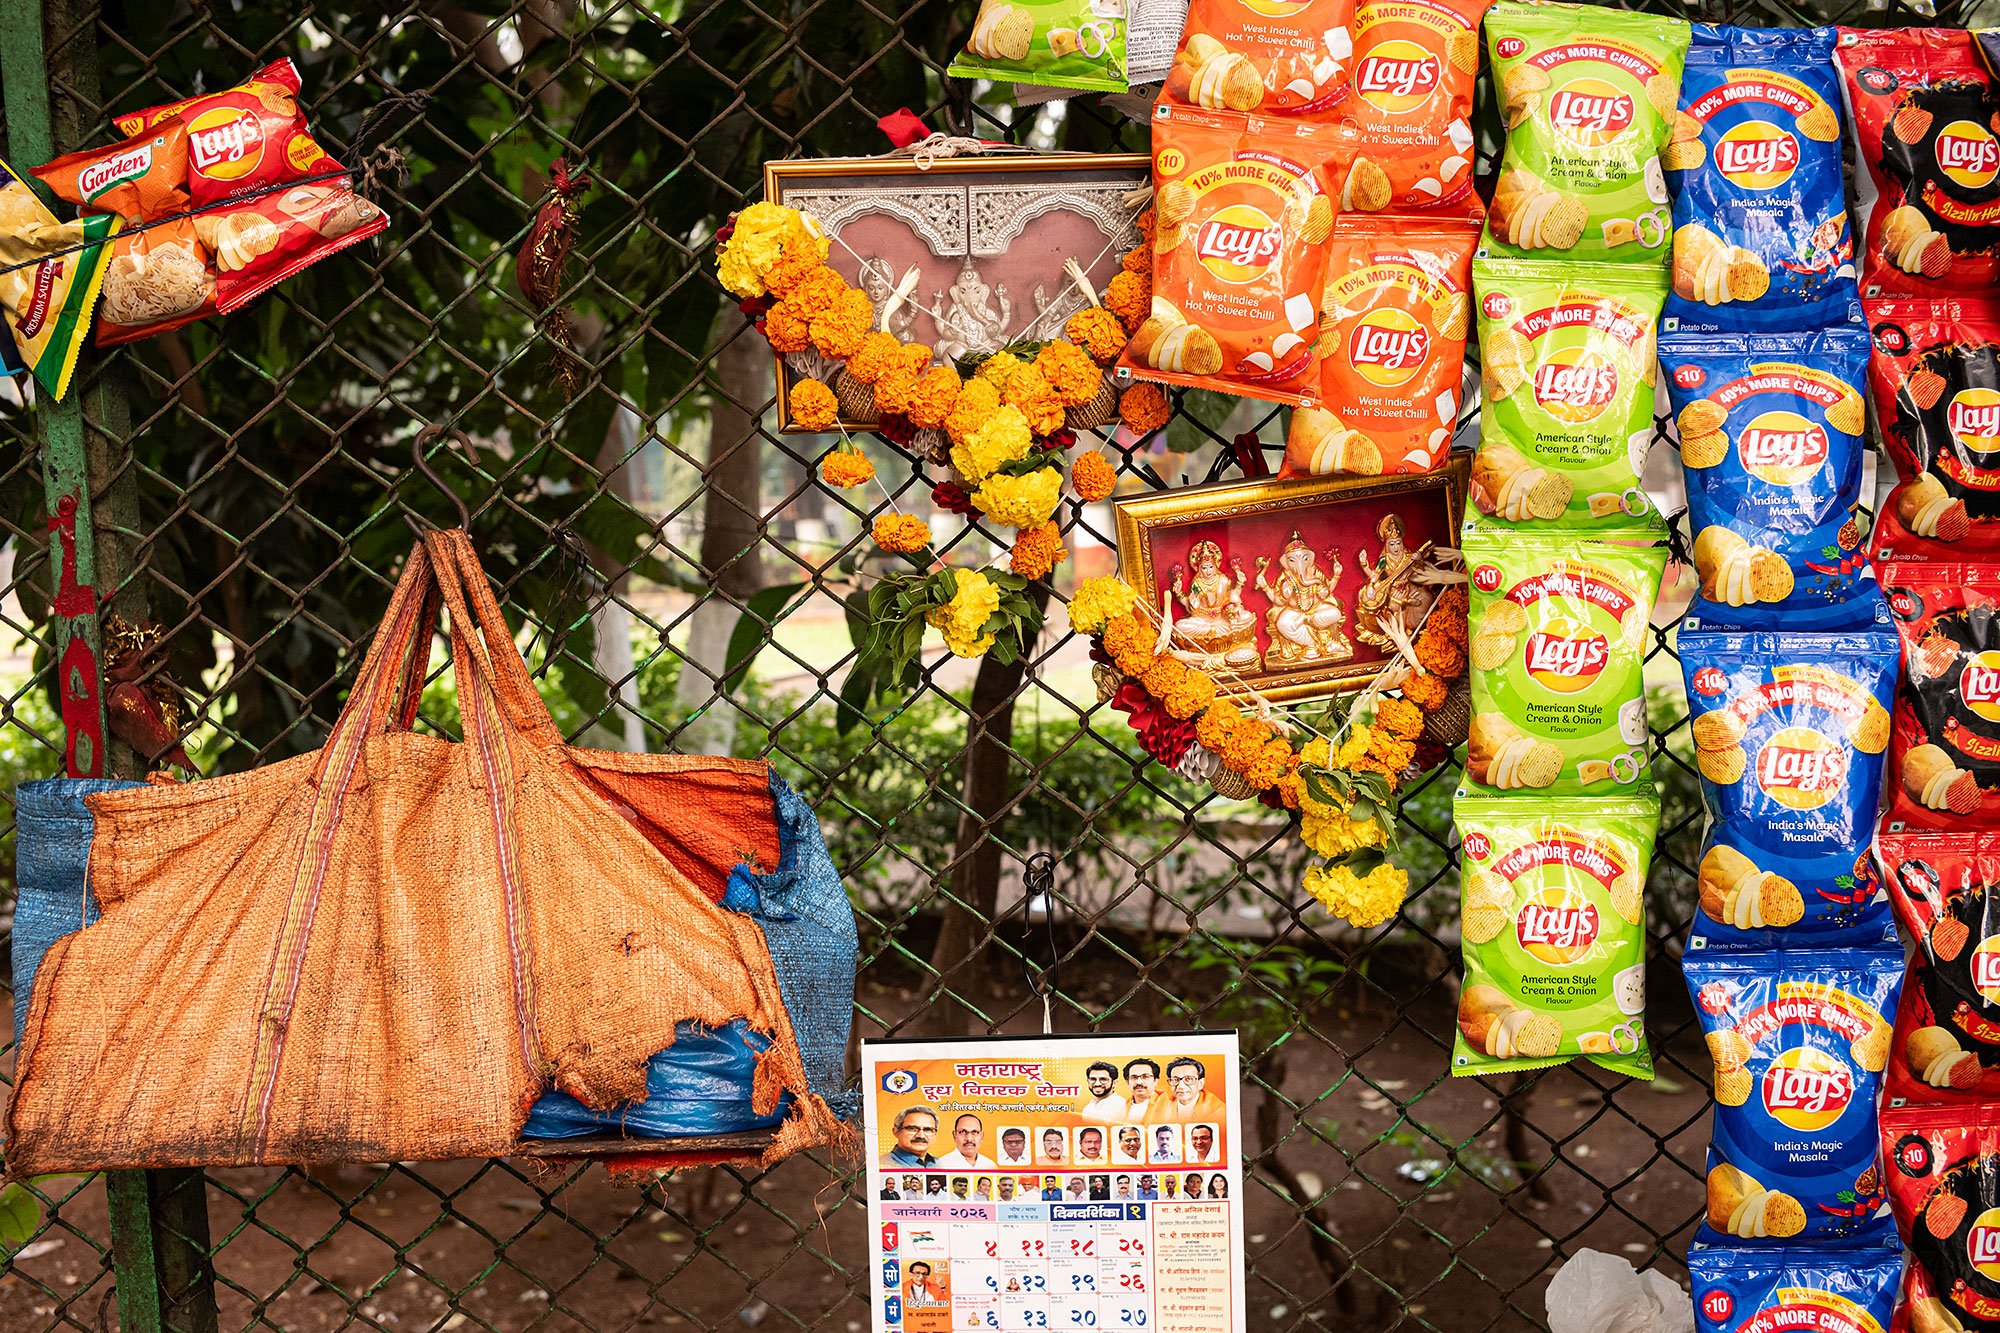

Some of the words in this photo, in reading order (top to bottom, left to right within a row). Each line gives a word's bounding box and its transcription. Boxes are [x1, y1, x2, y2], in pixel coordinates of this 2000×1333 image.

[1377, 7, 1416, 19] MORE
[1243, 24, 1267, 34] West
[1226, 33, 1242, 41] Hot
[1257, 35, 1288, 46] Sweet
[1289, 37, 1316, 50] Chilli
[1878, 37, 1895, 46] Chips
[1536, 50, 1567, 67] 10%
[1567, 46, 1607, 59] MORE
[1360, 57, 1435, 97] Lay's
[1777, 77, 1800, 90] PERFECT
[1694, 95, 1723, 119] 40%
[1722, 85, 1764, 102] MORE
[1172, 113, 1191, 122] Potato
[1192, 115, 1209, 124] Chips
[1554, 91, 1630, 132] Lay's
[1366, 123, 1392, 134] West
[190, 115, 262, 169] Lay's
[1382, 134, 1413, 146] Sweet
[1414, 134, 1440, 146] Chilli
[1722, 136, 1796, 175] Lay's
[1942, 136, 1998, 173] Lay's
[81, 154, 147, 193] Garden
[1281, 161, 1305, 175] PERFECT
[1551, 167, 1584, 178] Cream
[1586, 168, 1595, 178] &
[1192, 170, 1222, 190] 10%
[1225, 165, 1265, 180] MORE
[1574, 180, 1602, 188] Flavour
[229, 179, 266, 198] Spanish
[1731, 198, 1765, 207] India's
[1766, 198, 1796, 209] Magic
[1746, 208, 1784, 218] Masala
[1200, 221, 1283, 267] Lay's
[1338, 276, 1365, 296] 10%
[1366, 270, 1404, 283] MORE
[24, 299, 46, 336] PREMIUM
[37, 266, 52, 300] SALTED
[1202, 290, 1227, 302] West
[1185, 300, 1202, 311] Hot
[1217, 304, 1248, 318] Sweet
[1249, 307, 1275, 321] Chilli
[1522, 315, 1550, 335] 10%
[1550, 308, 1592, 323] MORE
[1680, 324, 1700, 332] Potato
[1701, 323, 1719, 332] Chips
[1353, 325, 1422, 370] Lay's
[1719, 383, 1749, 404] 40%
[1749, 377, 1790, 391] MORE
[1358, 396, 1383, 407] West
[1342, 406, 1360, 416] Hot
[1374, 407, 1403, 418] Sweet
[1404, 408, 1428, 419] Chilli
[1535, 432, 1585, 444] American
[1586, 434, 1613, 446] Style
[1535, 444, 1570, 455] Cream
[1572, 445, 1580, 455] &
[1582, 445, 1612, 456] Onion
[1745, 427, 1824, 469] Lay's
[1559, 456, 1587, 464] Flavour
[1753, 495, 1788, 505] India's
[1515, 582, 1542, 603] 10%
[1541, 579, 1581, 593] MORE
[1723, 624, 1741, 632] Chips
[1530, 634, 1604, 677] Lay's
[1770, 685, 1813, 702] MORE
[1526, 702, 1576, 714] American
[1577, 703, 1603, 717] Style
[1526, 713, 1561, 724] Cream
[1562, 714, 1571, 724] &
[1572, 714, 1602, 725] Onion
[1550, 725, 1577, 734] Flavour
[1763, 747, 1842, 792] Lay's
[1768, 820, 1804, 830] India's
[1805, 820, 1840, 833] Magic
[1782, 832, 1825, 842] Masala
[1502, 853, 1532, 875] 10%
[1532, 846, 1571, 860] MORE
[1521, 973, 1570, 985] American
[1572, 974, 1597, 987] Style
[1521, 985, 1556, 996] Cream
[1557, 986, 1566, 996] &
[1567, 985, 1597, 996] Onion
[1546, 997, 1573, 1005] Flavour
[1774, 1003, 1817, 1020] MORE
[956, 1063, 1043, 1082] महाराष्ट्र
[922, 1084, 953, 1101] दूध
[961, 1082, 1029, 1097] वितरक
[1037, 1082, 1081, 1097] सेना
[1769, 1066, 1847, 1114] Lay's
[1773, 1141, 1809, 1151] India's
[1811, 1140, 1843, 1154] Magic
[1788, 1152, 1828, 1162] Masala
[891, 1206, 943, 1218] जानेवारी
[950, 1207, 988, 1220] २०२६
[1052, 1204, 1121, 1219] दिनदर्शिका
[1129, 1205, 1142, 1219] १
[885, 1232, 896, 1247] र
[1021, 1239, 1044, 1257] ११
[1070, 1239, 1094, 1256] १८
[1119, 1238, 1145, 1256] २५
[984, 1240, 997, 1257] ४
[884, 1264, 898, 1283] सो
[985, 1275, 998, 1293] ५
[1023, 1275, 1047, 1293] १२
[1071, 1274, 1096, 1292] १९
[1120, 1274, 1145, 1293] २६
[888, 1302, 898, 1318] मं
[1071, 1309, 1096, 1327] २०
[1120, 1308, 1147, 1327] २७
[1774, 1310, 1816, 1326] MORE
[986, 1310, 999, 1329] ६
[1023, 1310, 1048, 1329] १३
